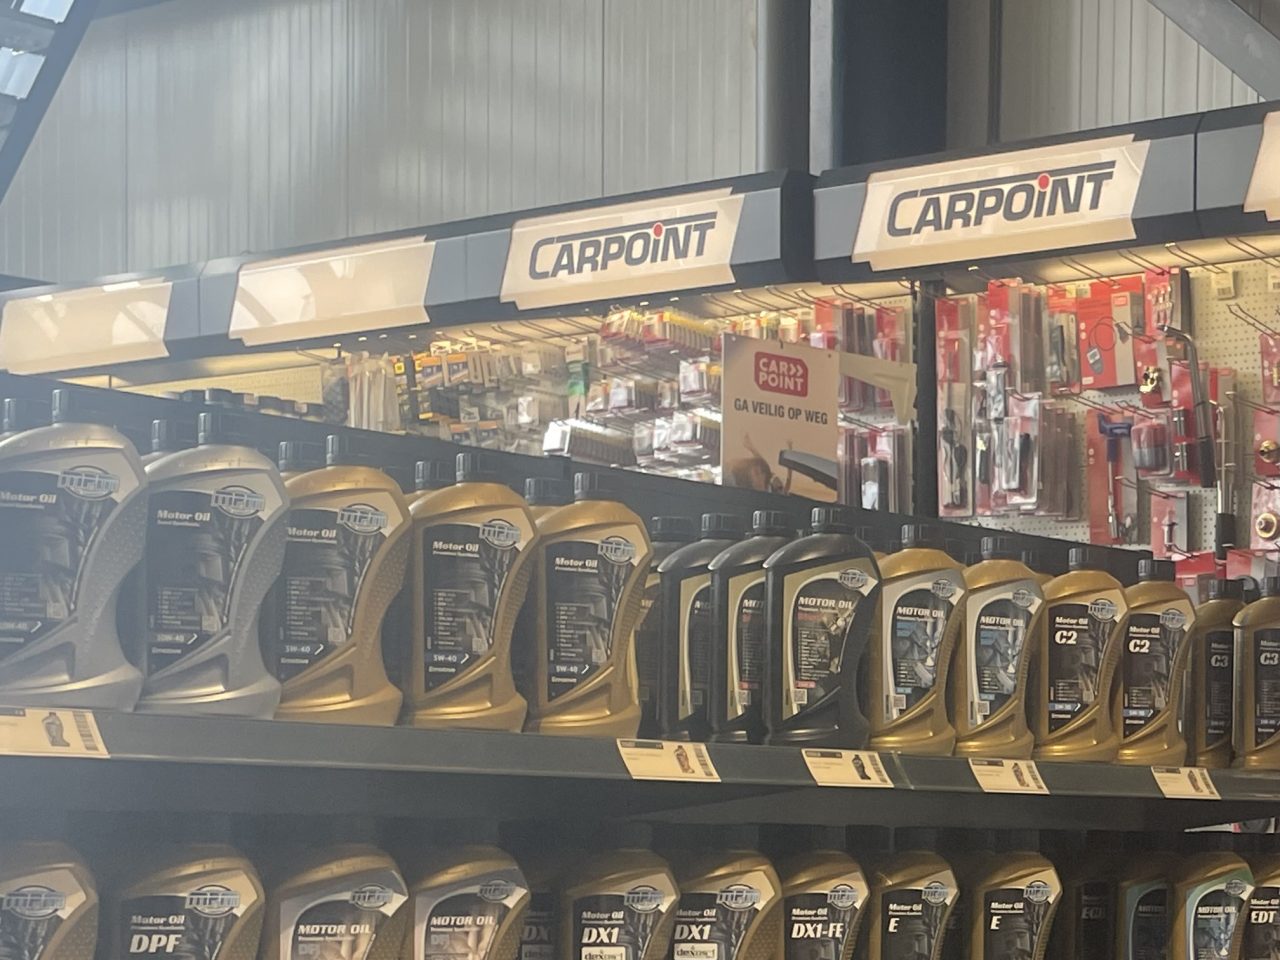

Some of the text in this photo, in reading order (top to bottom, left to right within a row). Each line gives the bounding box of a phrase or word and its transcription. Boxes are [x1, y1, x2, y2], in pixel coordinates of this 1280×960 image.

[759, 372, 807, 391] POINT
[734, 398, 828, 425] GA VEILIG OP WEG
[39, 494, 56, 503] Oil
[157, 510, 210, 521] Motor Oil
[287, 527, 337, 538] Motor Oil
[433, 541, 479, 551] Motor Oil
[555, 557, 598, 567] Motor Oil
[798, 597, 835, 607] MOTOR
[896, 607, 944, 618] MOTOR OIL
[980, 616, 1011, 625] MOTOR
[1055, 630, 1078, 644] C2
[1129, 639, 1150, 653] C2
[1211, 655, 1228, 667] C3
[1260, 652, 1279, 665] C3
[991, 902, 1012, 910] Motor
[581, 911, 624, 919] Motor Oil
[676, 909, 716, 918] Motor Oil
[792, 908, 828, 916] Motor Oil
[1251, 911, 1277, 923] EDT
[130, 915, 185, 924] Motor Oil
[430, 916, 495, 926] MOTOR OIL
[990, 916, 1002, 930] E
[298, 924, 370, 935] MOTOR OIL
[791, 922, 844, 938] DX1-FE
[888, 918, 899, 933] E
[581, 927, 620, 944] DX1
[674, 924, 712, 940] DX1
[129, 934, 182, 953] DPF
